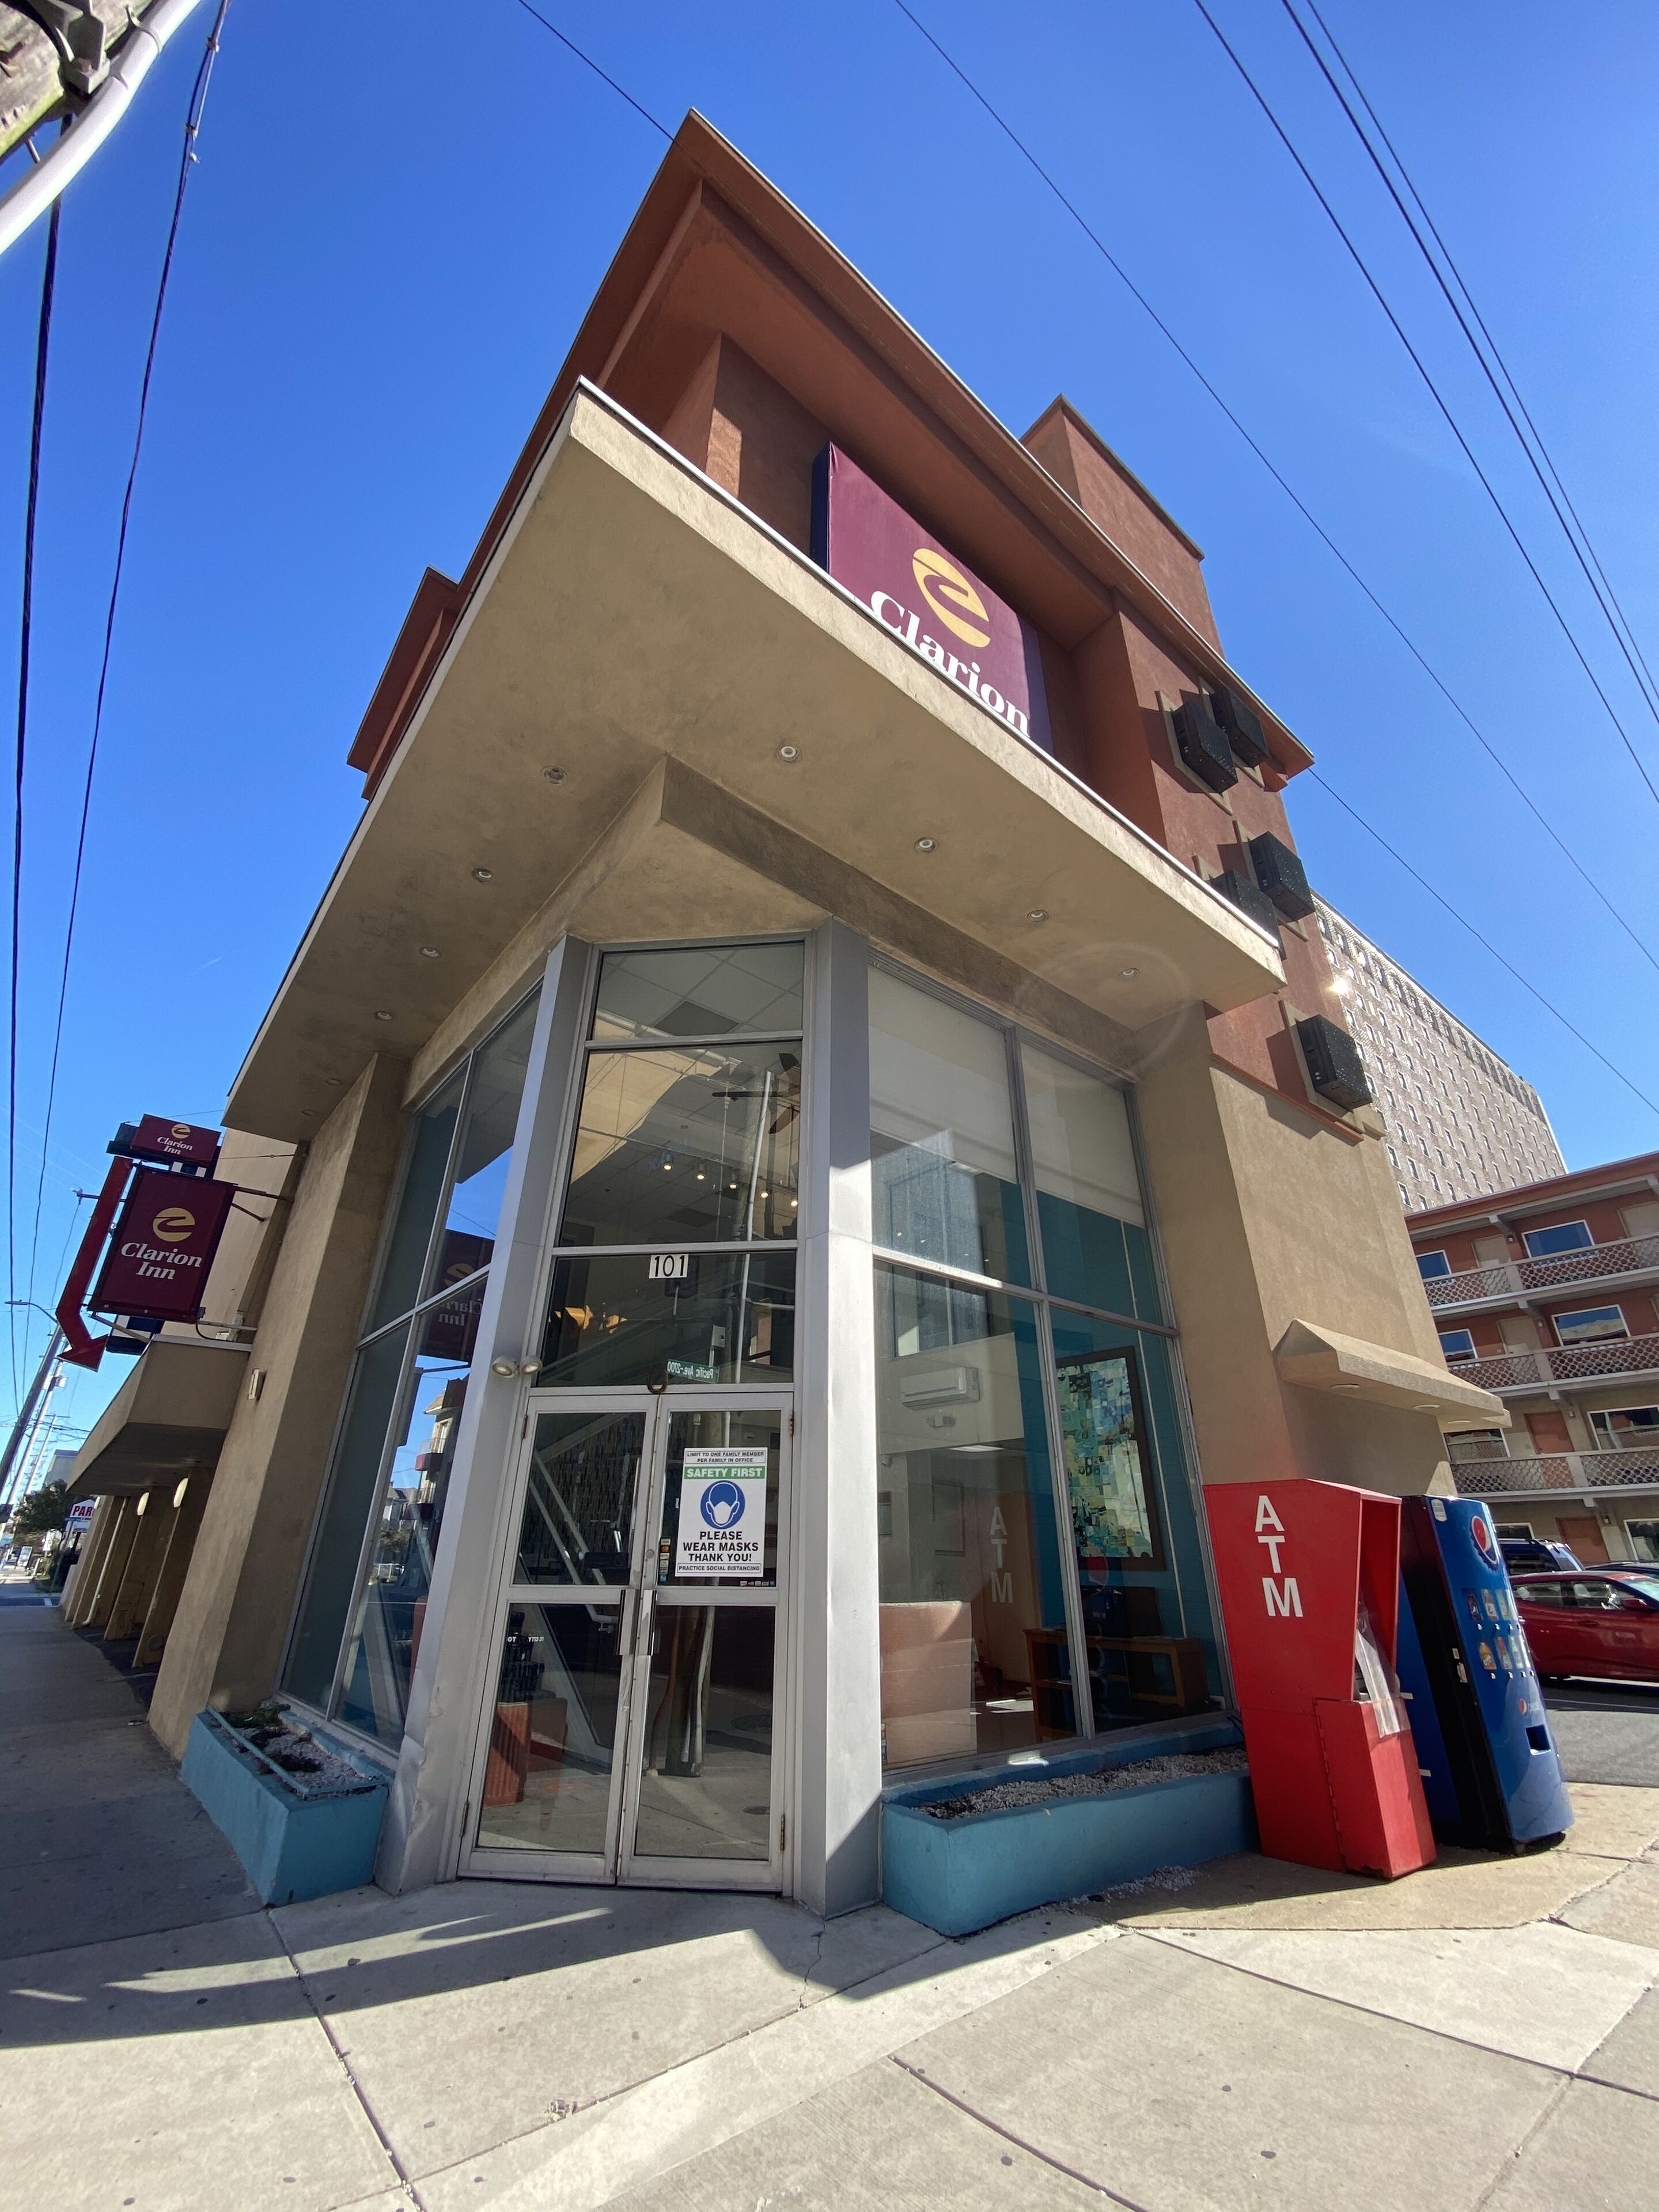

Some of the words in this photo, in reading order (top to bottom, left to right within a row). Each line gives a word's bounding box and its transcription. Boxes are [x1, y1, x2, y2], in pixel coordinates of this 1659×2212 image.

[871, 591, 1031, 738] Clarion
[157, 1137, 193, 1150] Clarion
[163, 1145, 181, 1155] Inn
[122, 1243, 202, 1267] Clarion
[135, 1261, 175, 1279] Inn
[654, 1255, 685, 1277] 101
[687, 1468, 728, 1478] SAFETY
[731, 1468, 762, 1477] FIRST
[699, 1531, 743, 1540] PLEASE
[683, 1542, 715, 1551] WEAR
[719, 1542, 759, 1551] MASKS
[688, 1554, 724, 1562] THANK
[727, 1554, 752, 1562] YOU!
[1255, 1495, 1304, 1618] ATM
